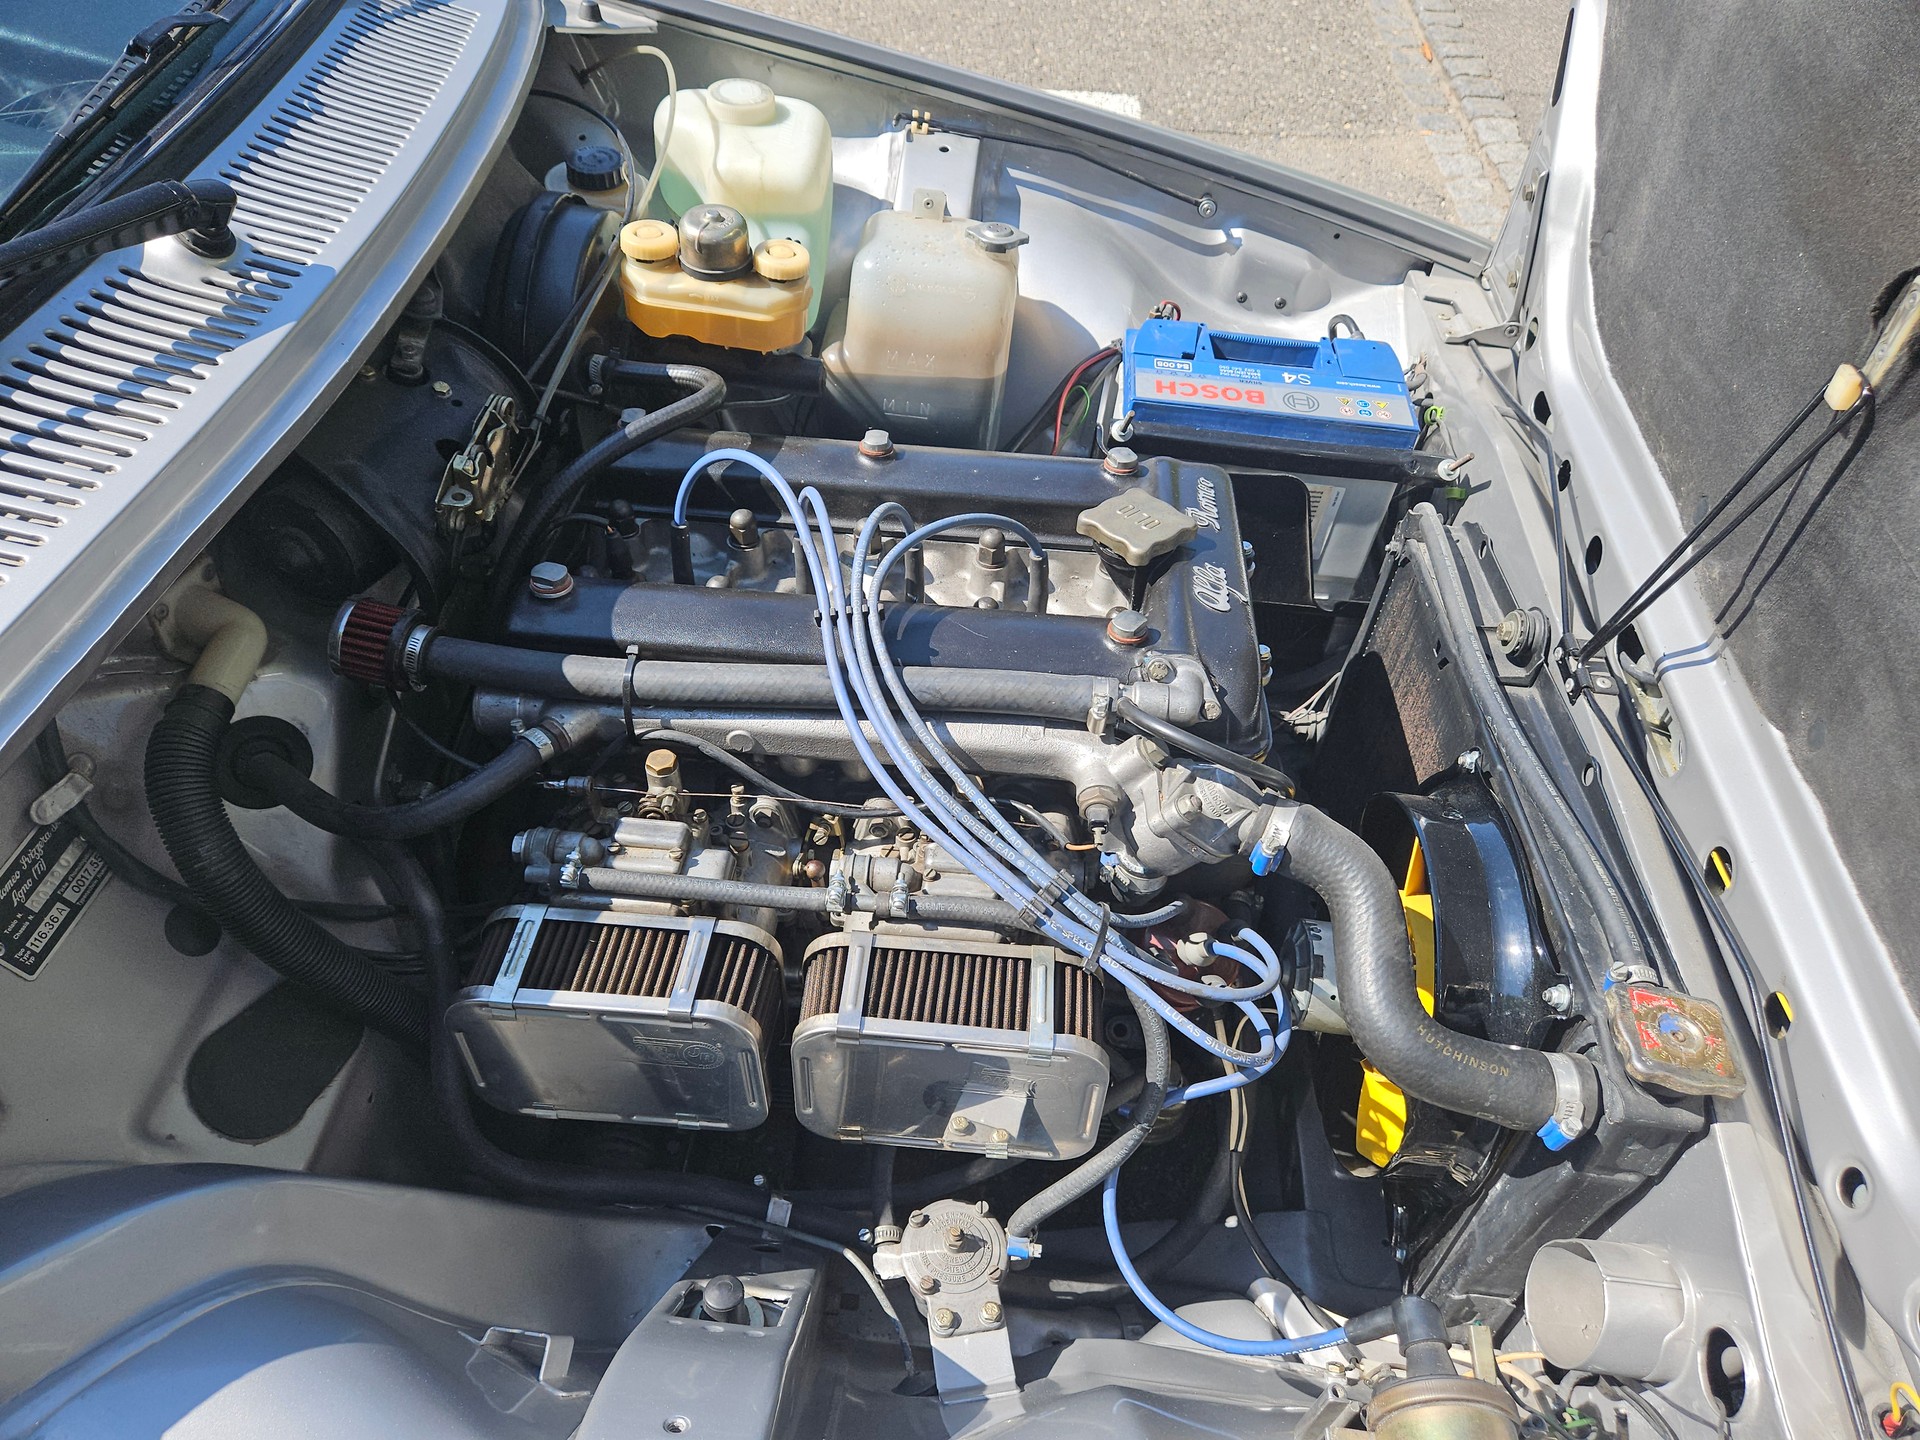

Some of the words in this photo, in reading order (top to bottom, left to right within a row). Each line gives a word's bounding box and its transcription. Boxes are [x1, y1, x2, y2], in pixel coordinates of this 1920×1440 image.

[886, 350, 936, 368] MAX
[1282, 371, 1312, 385] S4
[1155, 379, 1266, 405] BOSCH
[883, 398, 932, 416] MIN
[1116, 504, 1162, 530] OLIO
[1185, 477, 1220, 533] Romeo
[1192, 562, 1246, 612] Alfa
[914, 723, 939, 755] LUCAS
[939, 756, 976, 797] SILICONE
[976, 798, 1022, 849] SPEEDLEAD
[897, 740, 922, 774] LUCAS
[921, 773, 962, 816] SILICONE
[961, 815, 1016, 861] SPEEDLEAD
[0, 870, 21, 900] omeo
[20, 832, 52, 869] Svizzera
[12, 879, 33, 907] Agno
[4, 919, 18, 934] Telaio
[13, 921, 30, 940] Chassis
[30, 914, 60, 949] 116.36
[56, 906, 67, 916] A
[14, 948, 26, 960] Tipo
[20, 950, 32, 962] Type
[26, 956, 36, 966] Typ
[1165, 1006, 1200, 1037] LUCAS
[1204, 1036, 1252, 1064] SILICONE
[1416, 1024, 1510, 1078] HUTCHINSON
[930, 1267, 966, 1282] PRESSURE
